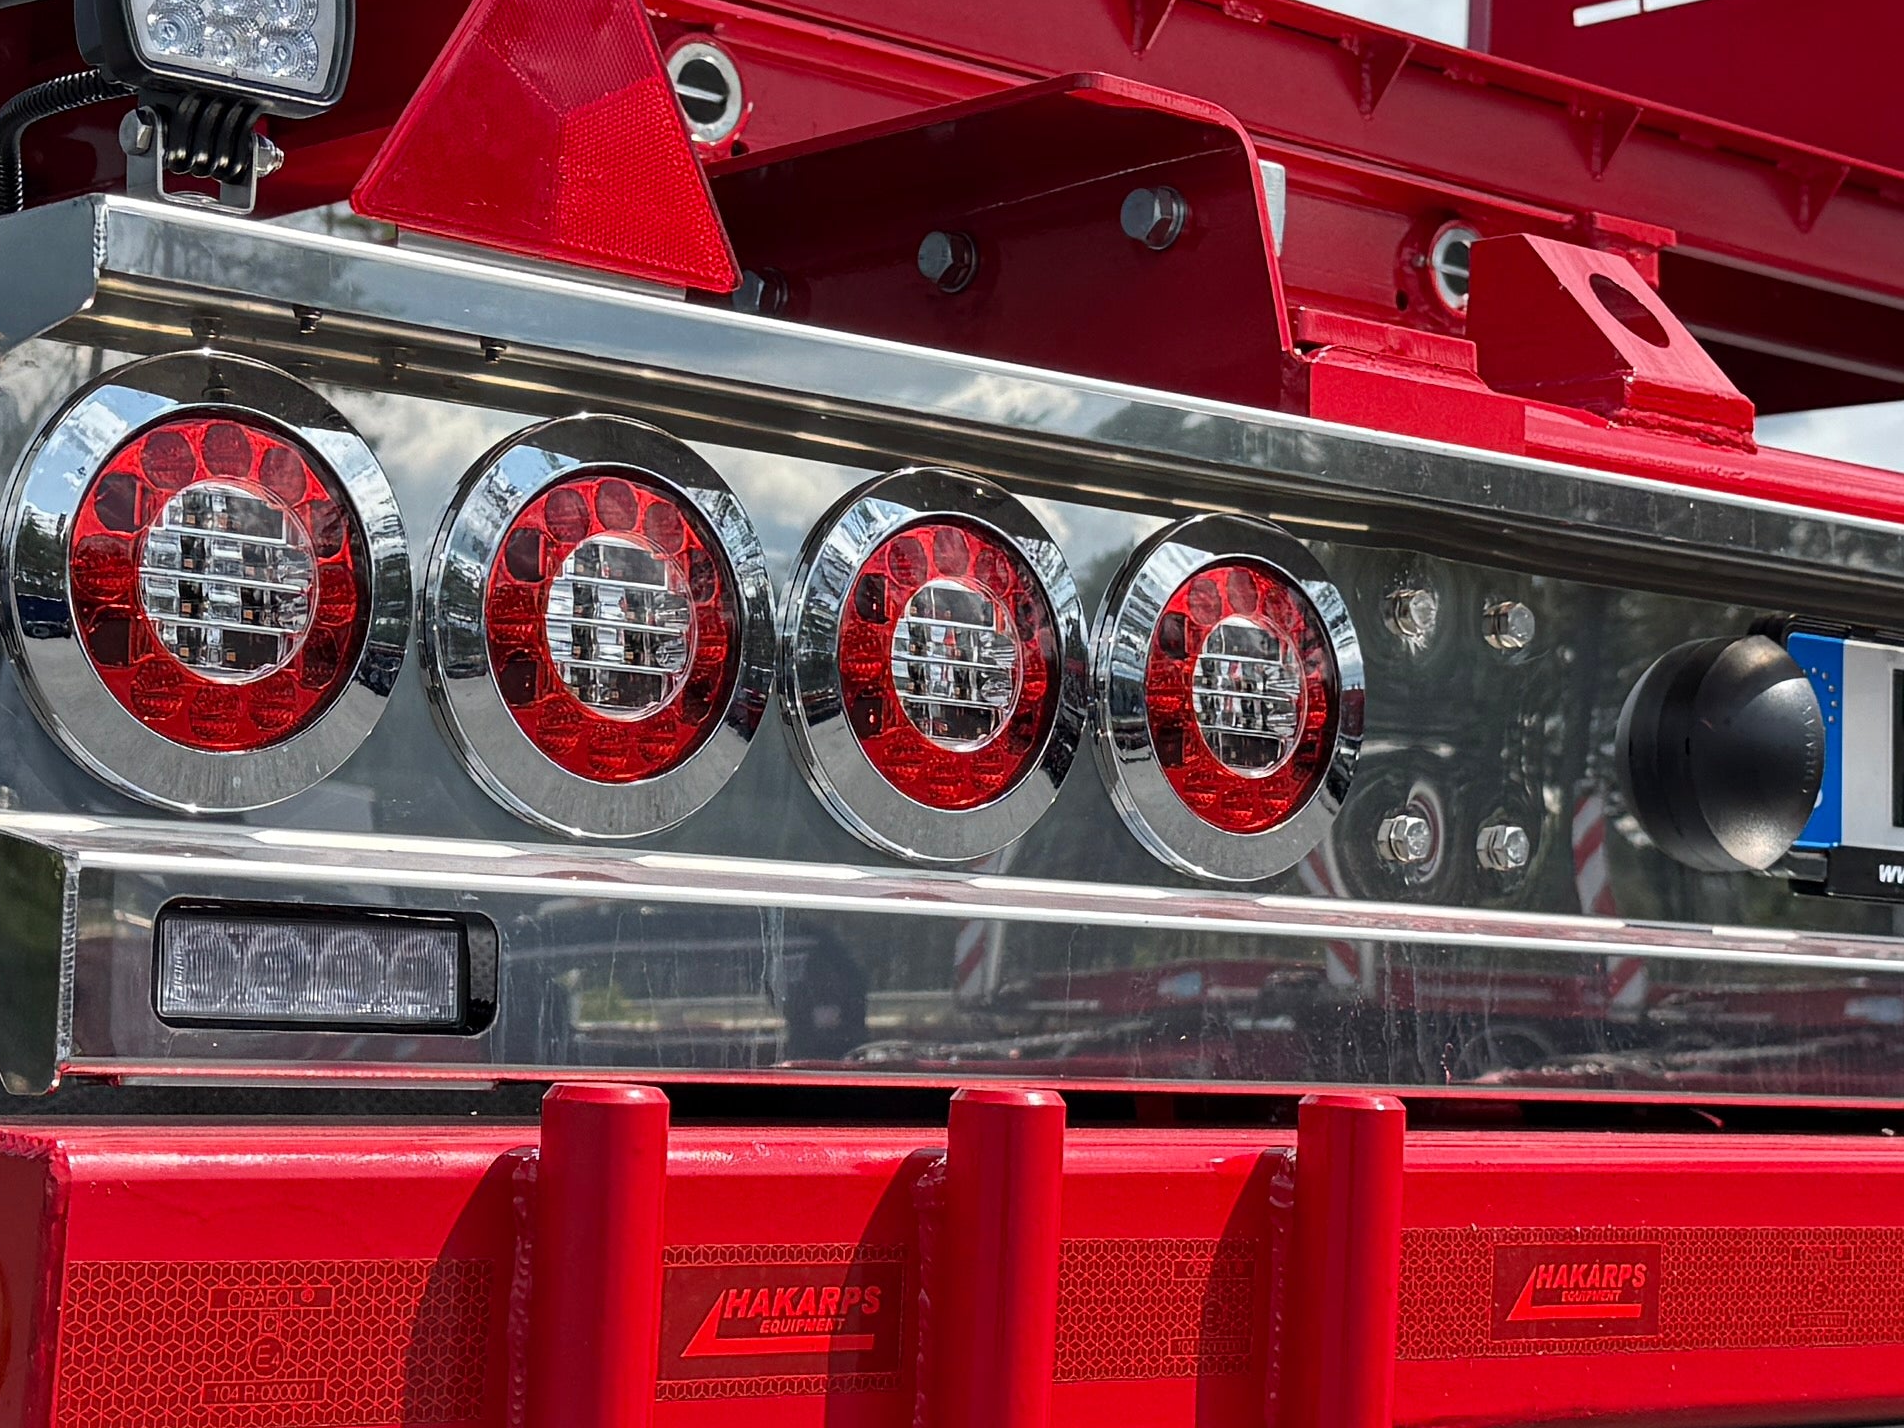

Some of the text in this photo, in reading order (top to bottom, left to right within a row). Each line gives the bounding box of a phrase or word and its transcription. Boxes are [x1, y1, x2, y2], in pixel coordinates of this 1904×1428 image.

[1536, 1263, 1647, 1289] HAKARPS
[723, 1286, 881, 1318] HAKARPS
[263, 1315, 277, 1331] C
[760, 1318, 845, 1334] EQUIPMENT
[213, 1386, 239, 1402] 104
